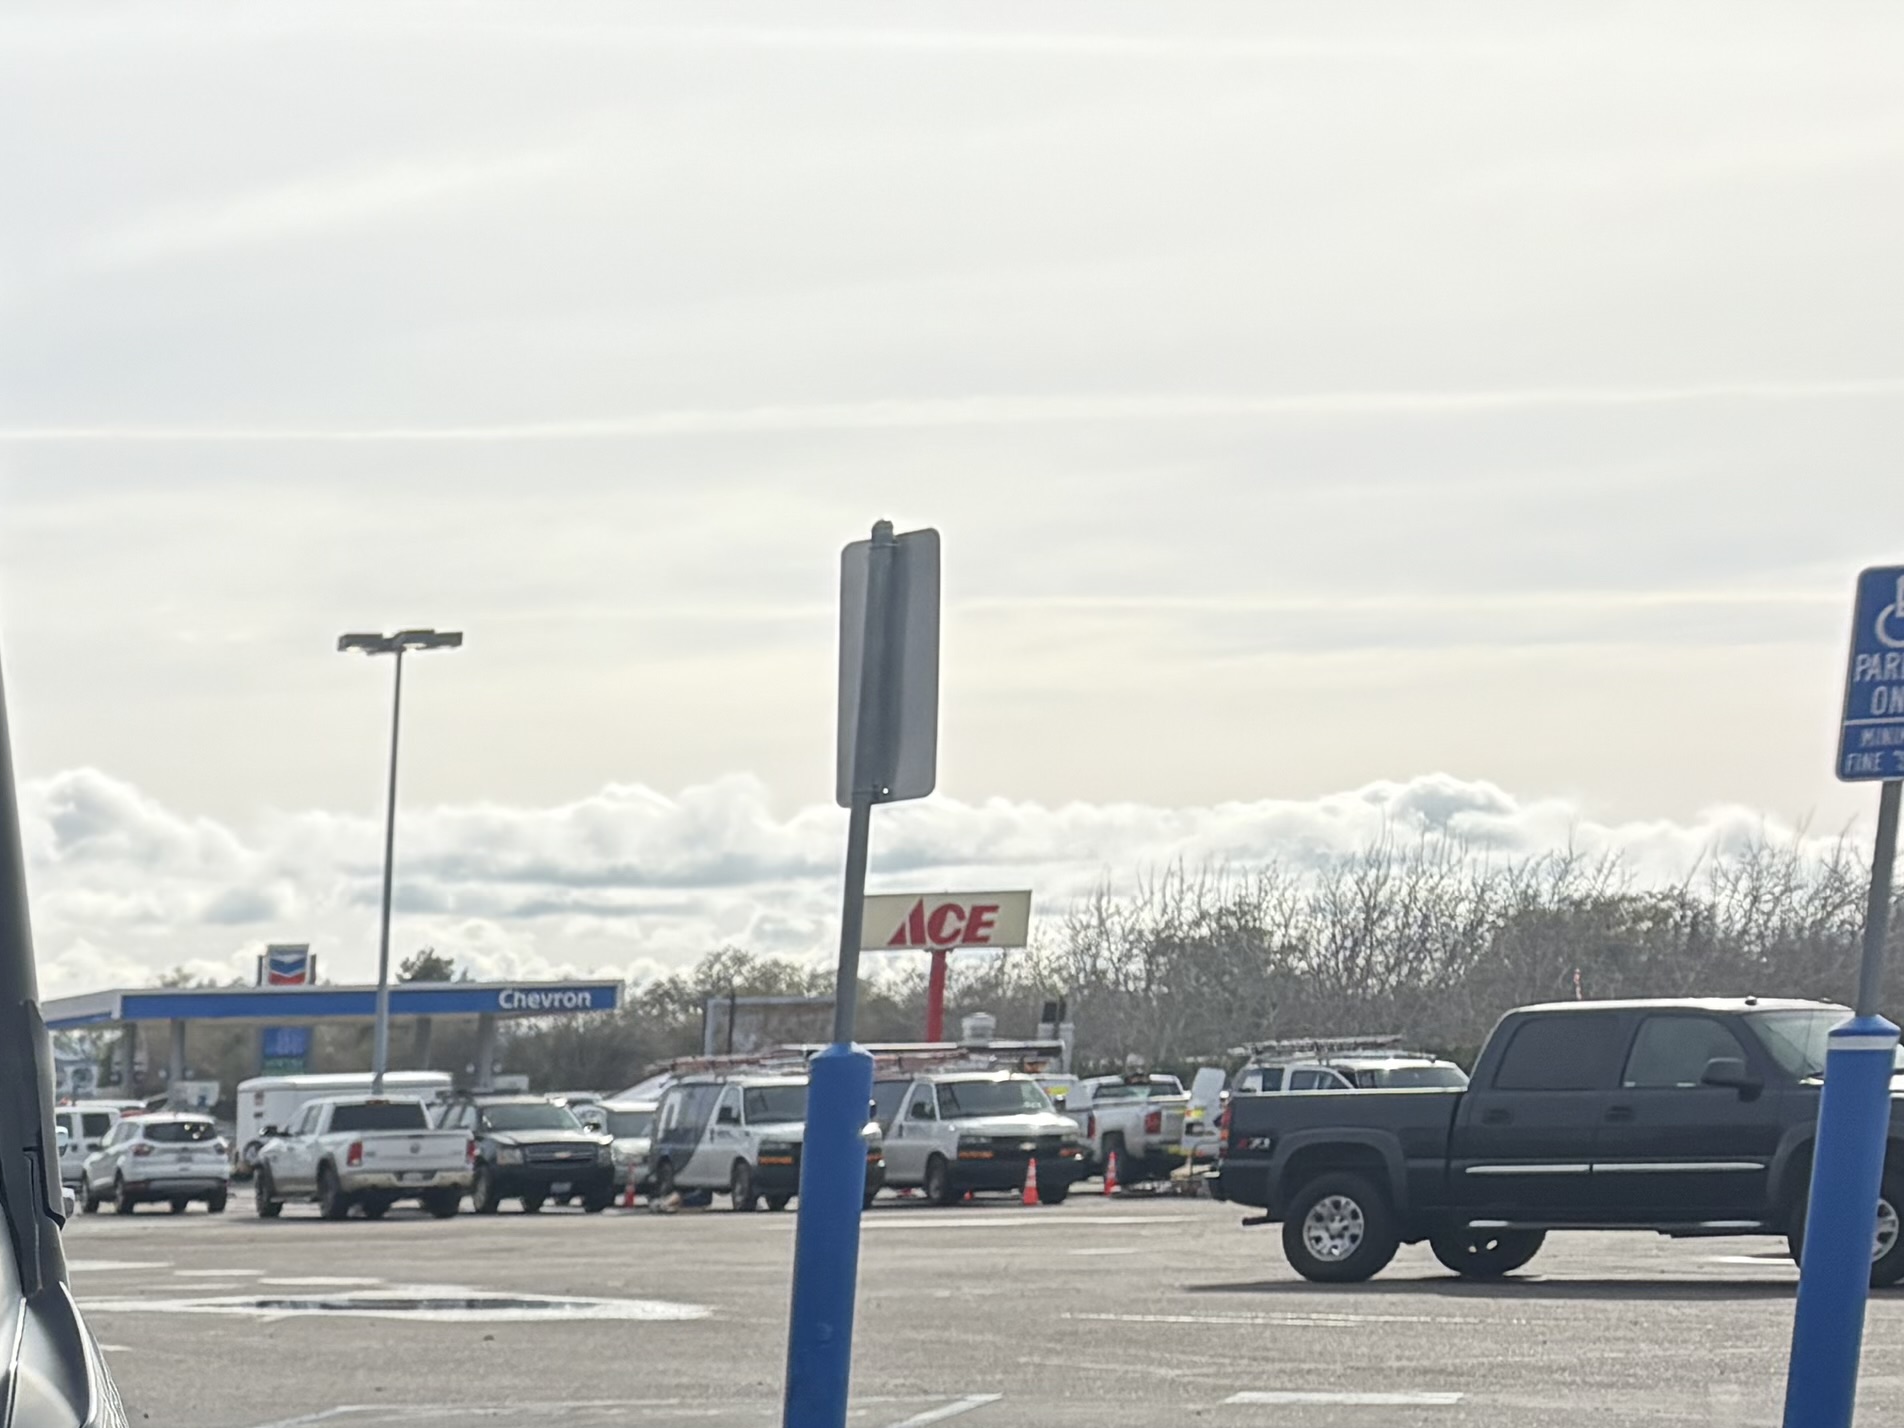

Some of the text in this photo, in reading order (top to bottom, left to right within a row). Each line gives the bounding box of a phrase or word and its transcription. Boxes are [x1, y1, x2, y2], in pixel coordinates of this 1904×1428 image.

[1852, 652, 1904, 682] PAR
[886, 896, 1000, 946] ACE
[498, 989, 592, 1010] Chevron
